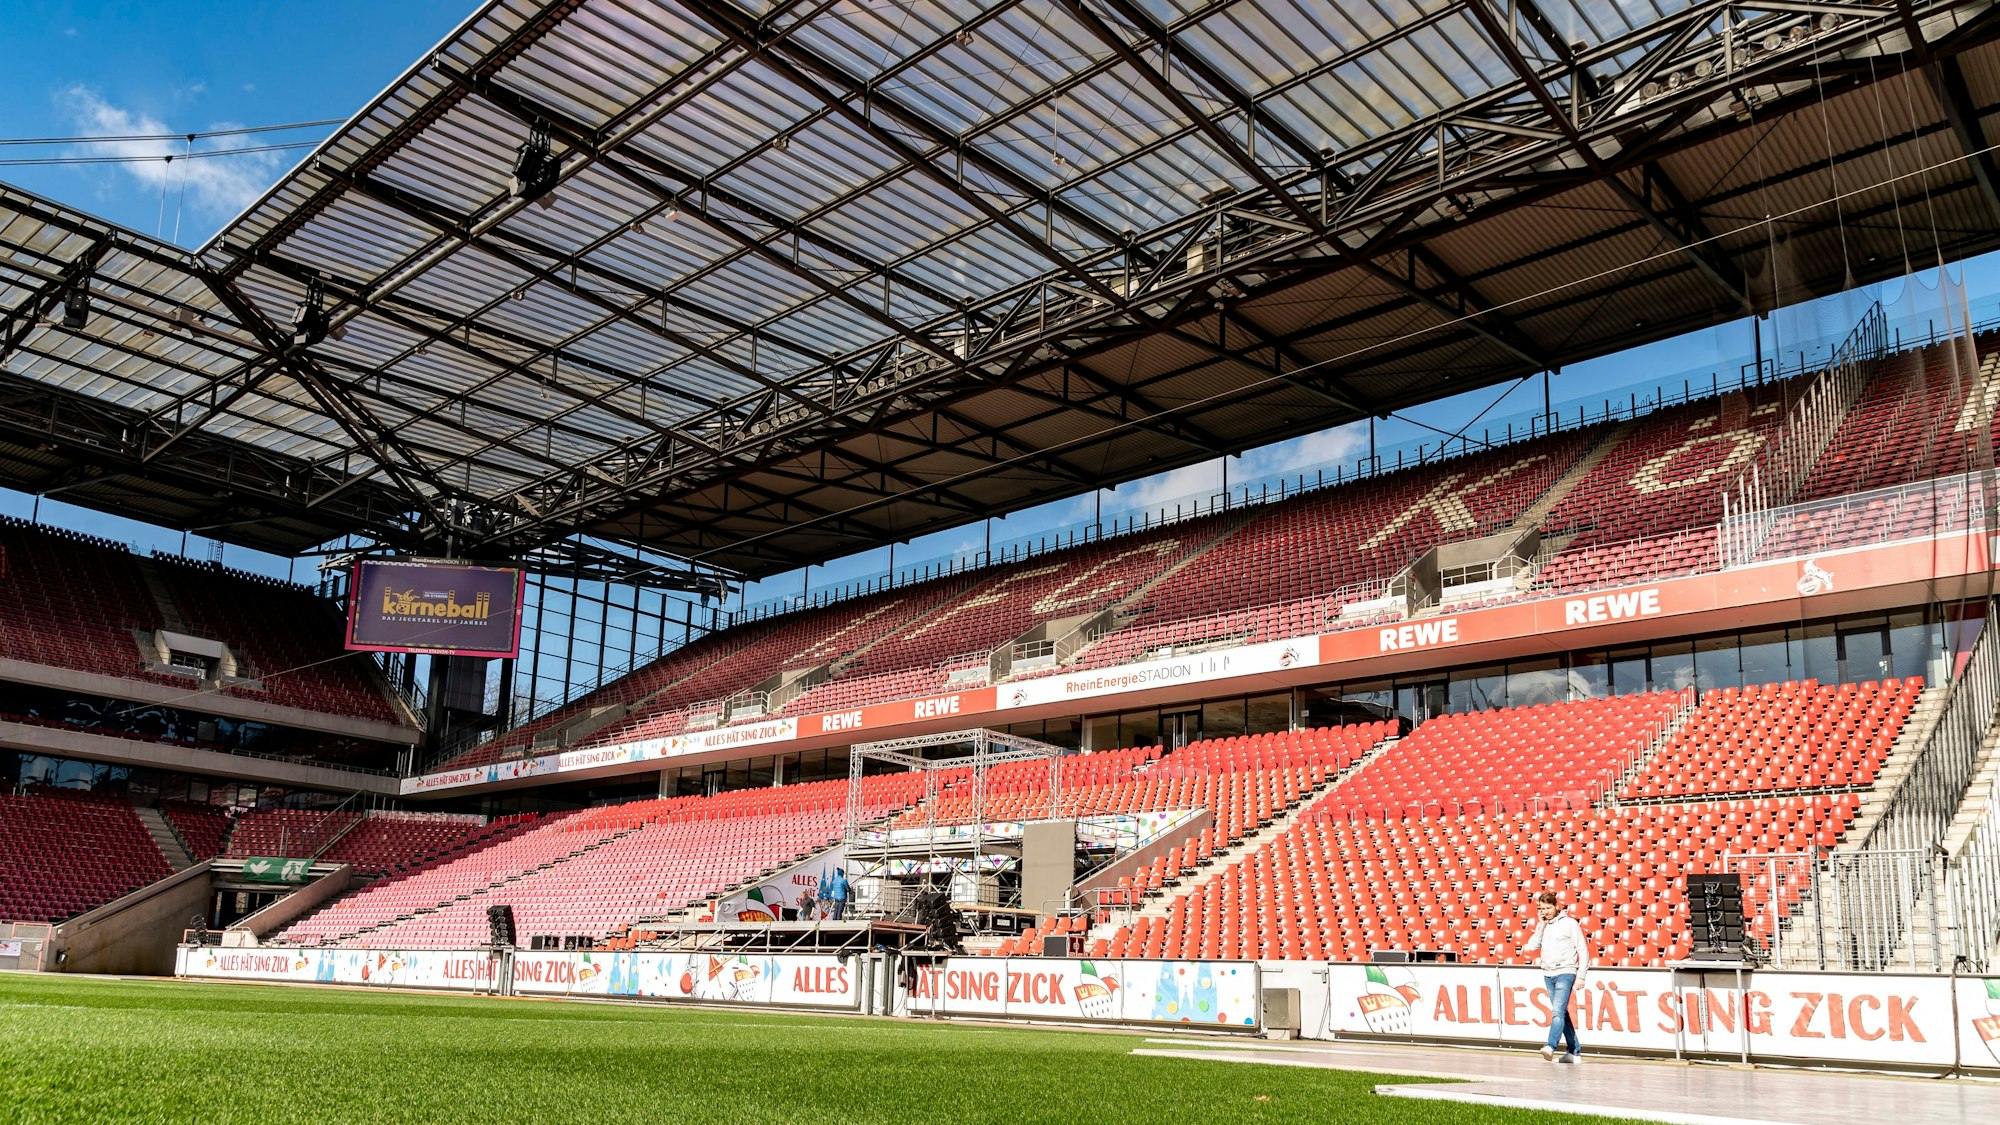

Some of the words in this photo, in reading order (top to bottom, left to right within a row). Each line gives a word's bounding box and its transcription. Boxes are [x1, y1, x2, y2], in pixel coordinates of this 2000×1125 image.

[383, 586, 490, 619] karneball
[1565, 588, 1662, 626] REWE
[1379, 618, 1459, 652] REWE
[1066, 664, 1192, 694] RheinEnergieSTADION
[914, 695, 960, 719] REWE
[822, 710, 863, 732] REWE
[704, 733, 726, 747] ALLES
[726, 729, 740, 744] HÄT
[740, 728, 758, 742] SING
[759, 726, 778, 739] ZICK
[557, 756, 575, 768] ALLES
[575, 753, 586, 766] HÄT
[586, 752, 600, 764] SING
[600, 750, 616, 762] ZICK
[426, 777, 439, 787] ALLES
[459, 772, 471, 782] ZICK
[791, 873, 818, 887] ALLES
[220, 955, 240, 971] ALLES
[240, 952, 254, 971] HÄT
[254, 955, 271, 972] SING
[271, 955, 290, 973] ZICK
[442, 959, 475, 980] ALLES
[477, 955, 499, 981] HÄT
[514, 960, 542, 983] SING
[544, 960, 577, 984] ZICK
[793, 965, 849, 994] ALLES
[946, 970, 1000, 1002] SING
[1007, 971, 1066, 1005] ZICK
[1433, 984, 1553, 1028] ALLES
[1566, 980, 1648, 1033] HÄT
[1657, 988, 1773, 1036] SING
[1789, 991, 1927, 1043] ZICK
